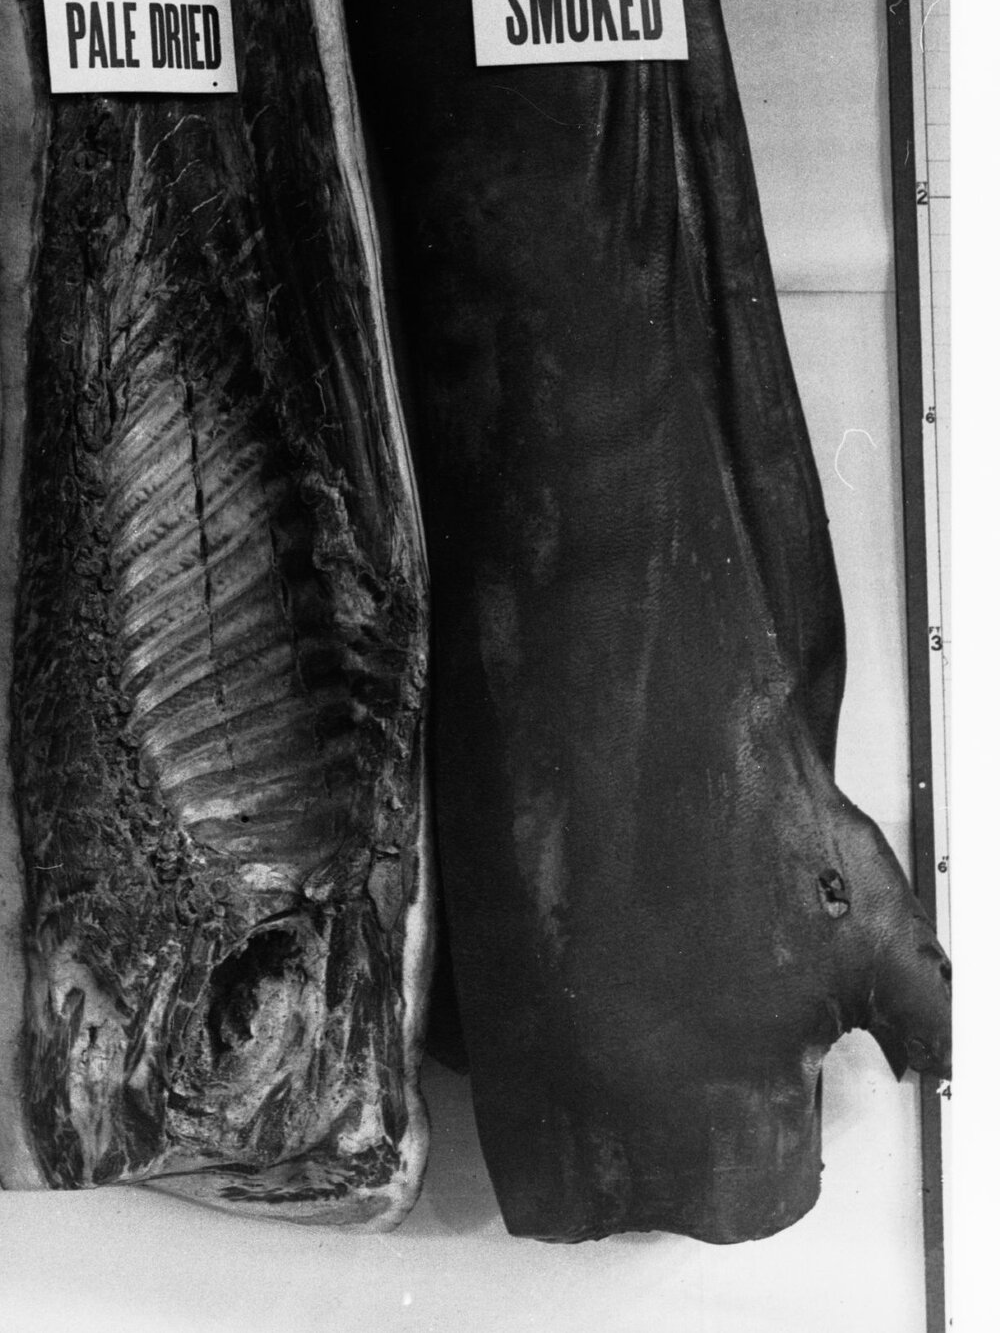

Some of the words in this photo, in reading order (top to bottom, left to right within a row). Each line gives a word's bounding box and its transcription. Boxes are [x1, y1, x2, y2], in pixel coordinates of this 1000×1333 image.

[65, 1, 140, 69] PALE
[148, 2, 222, 70] DRIED
[917, 188, 928, 205] 2
[931, 635, 943, 652] 3
